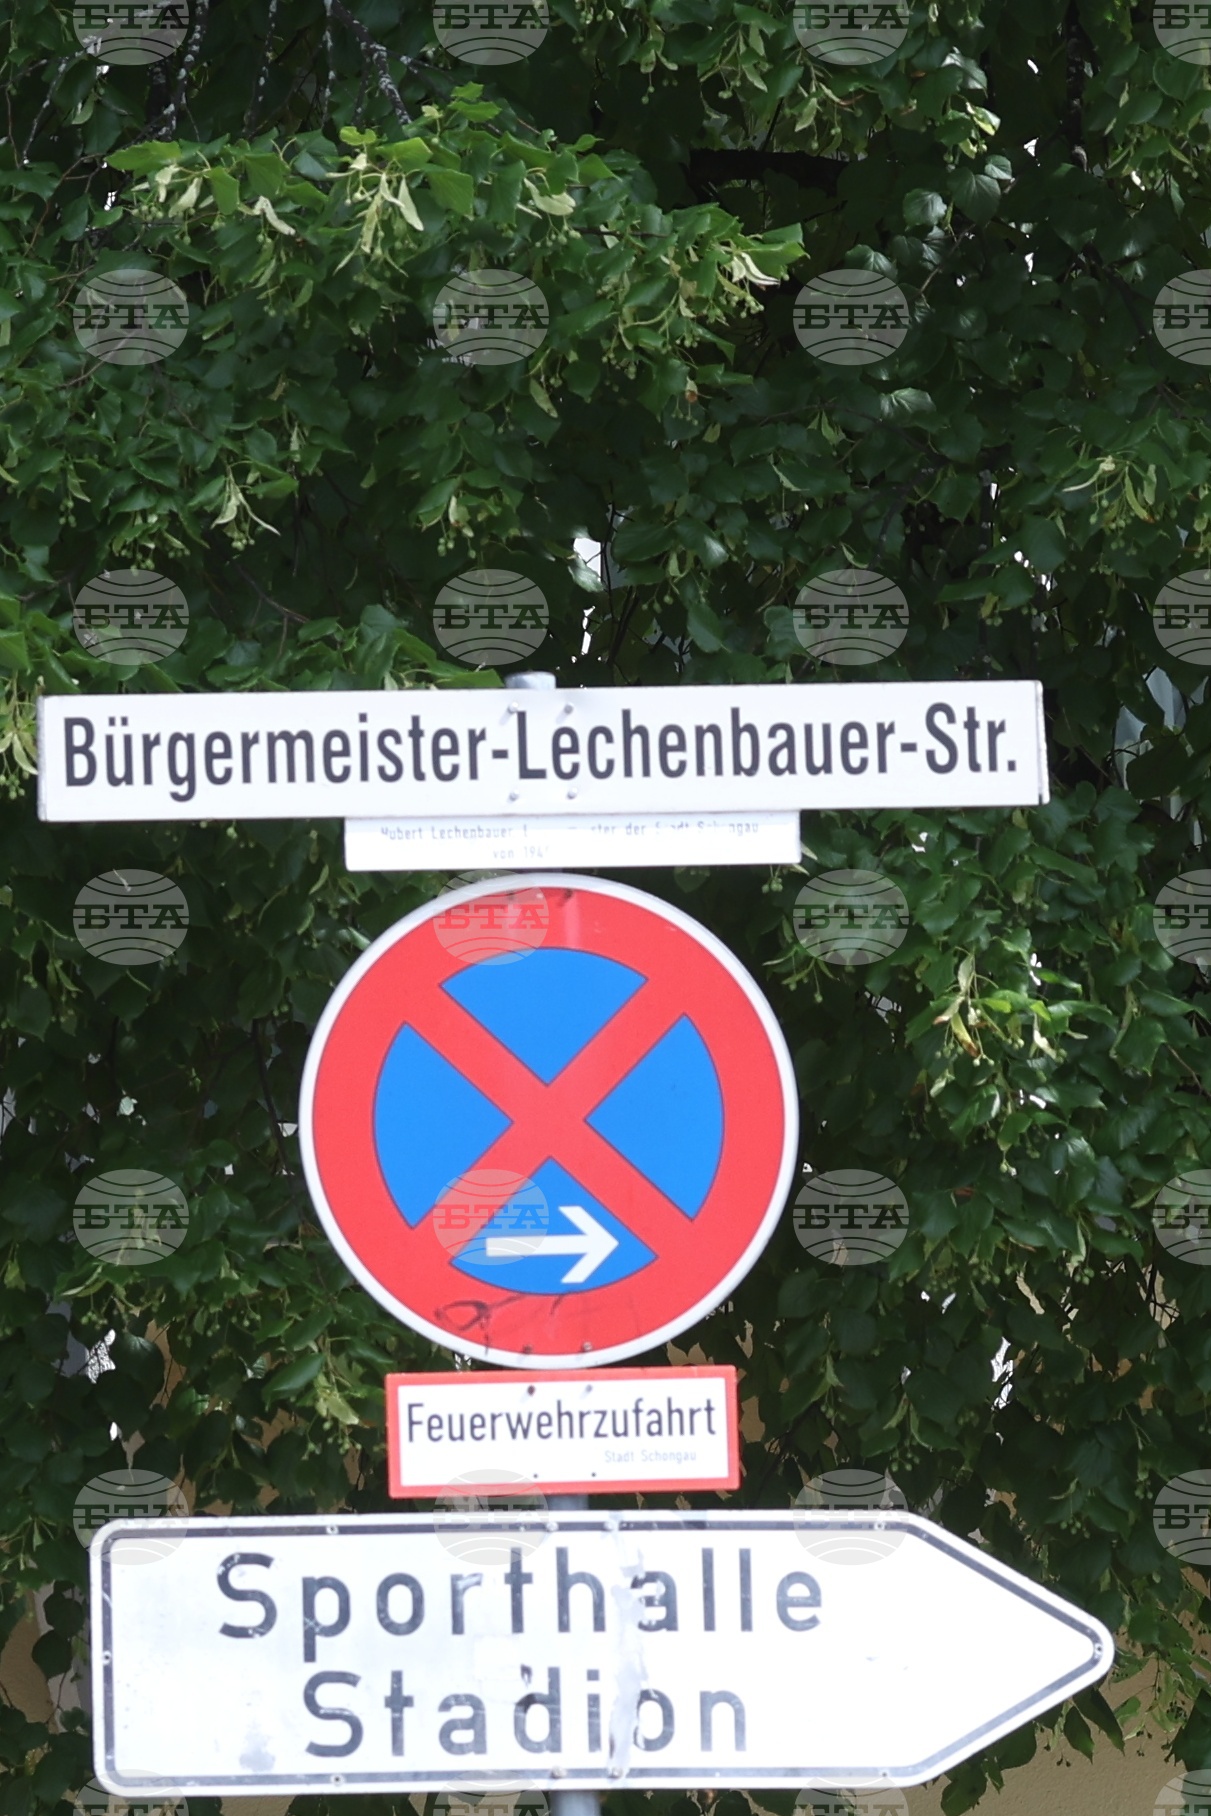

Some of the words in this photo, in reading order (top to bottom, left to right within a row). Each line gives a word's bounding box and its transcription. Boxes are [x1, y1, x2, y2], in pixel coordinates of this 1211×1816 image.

[64, 702, 1018, 802] Bürgermeister-Lechenbauer-Str.
[407, 1397, 716, 1443] Feuerwehrzufahrt
[605, 1449, 634, 1463] Stadt
[641, 1449, 697, 1464] Schongau
[216, 1547, 824, 1663] Sporthalle
[303, 1666, 748, 1757] Stadion
